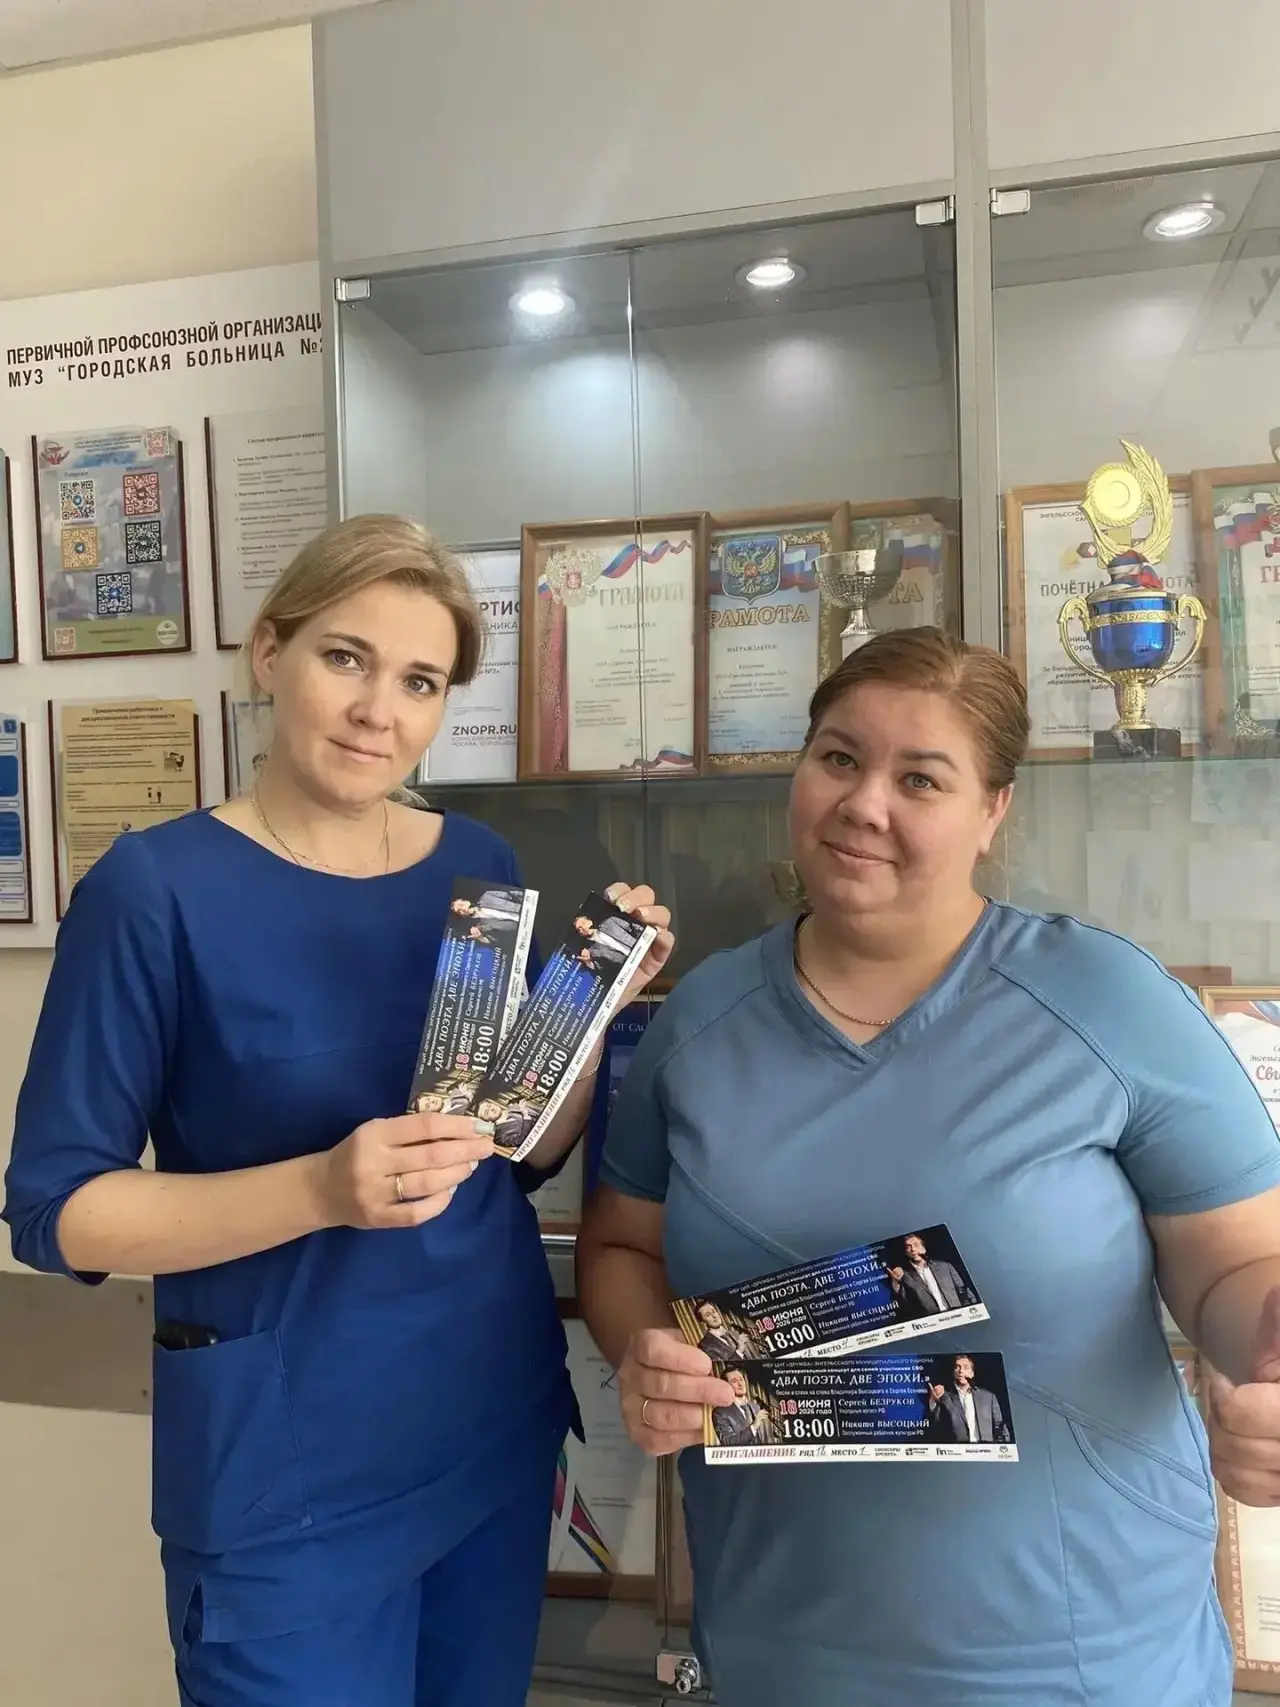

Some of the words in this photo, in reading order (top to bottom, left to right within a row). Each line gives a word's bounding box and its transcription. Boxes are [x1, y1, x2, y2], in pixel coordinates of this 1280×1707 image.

[7, 336, 94, 365] ПЕРВИЧНОЙ
[98, 321, 218, 354] ПРОФСОЮЗНОЙ
[8, 369, 44, 388] МУЗ
[58, 354, 171, 381] “ГОРОДСКАЯ
[186, 341, 285, 367] БОЛЬНИЦА
[1041, 579, 1106, 596] ПОЧЁТНА
[452, 725, 516, 736] ZNOPR.RU
[446, 980, 459, 1001] ДВЕ
[438, 1003, 454, 1041] ПОЭТА.
[457, 1021, 471, 1052] ИЮНЯ
[470, 1024, 495, 1073] 18:00
[501, 1056, 521, 1083] «ДВА
[515, 1018, 541, 1055] ПОЭТА.
[536, 996, 553, 1018] ДВЕ
[432, 1045, 446, 1072] «ДВА
[453, 1052, 470, 1071] 18
[528, 1040, 550, 1071] ИЮНЯ
[520, 1068, 539, 1089] 18
[533, 1048, 570, 1096] 18:00
[739, 1293, 768, 1311] «ДВА
[769, 1280, 811, 1300] ПОЭТА.
[812, 1273, 835, 1288] ДВЕ
[809, 1297, 836, 1311] Сергей
[837, 1284, 880, 1302] БЕЗРУКОВ
[754, 1315, 775, 1334] 18
[772, 1306, 804, 1322] ИЮНЯ
[775, 1319, 791, 1328] 2026
[817, 1314, 849, 1329] Никита
[850, 1300, 900, 1321] ВЫСОЦКИЙ
[764, 1322, 815, 1352] 18:00
[816, 1343, 841, 1355] МЕСТО
[771, 1376, 798, 1387] «ДВА
[803, 1375, 846, 1385] ПОЭТА.
[849, 1374, 872, 1386] ДВЕ
[877, 1374, 930, 1383] ЭПОХИ.»
[780, 1400, 798, 1415] 18
[798, 1400, 830, 1408] ИЮНЯ
[839, 1398, 866, 1407] Сергей
[870, 1398, 914, 1406] БЕЗРУКОВ
[782, 1418, 835, 1438] 18:00
[878, 1419, 930, 1428] ВЫСОЦКИЙ
[711, 1448, 796, 1459] ПРИГЛАШЕНИЕ
